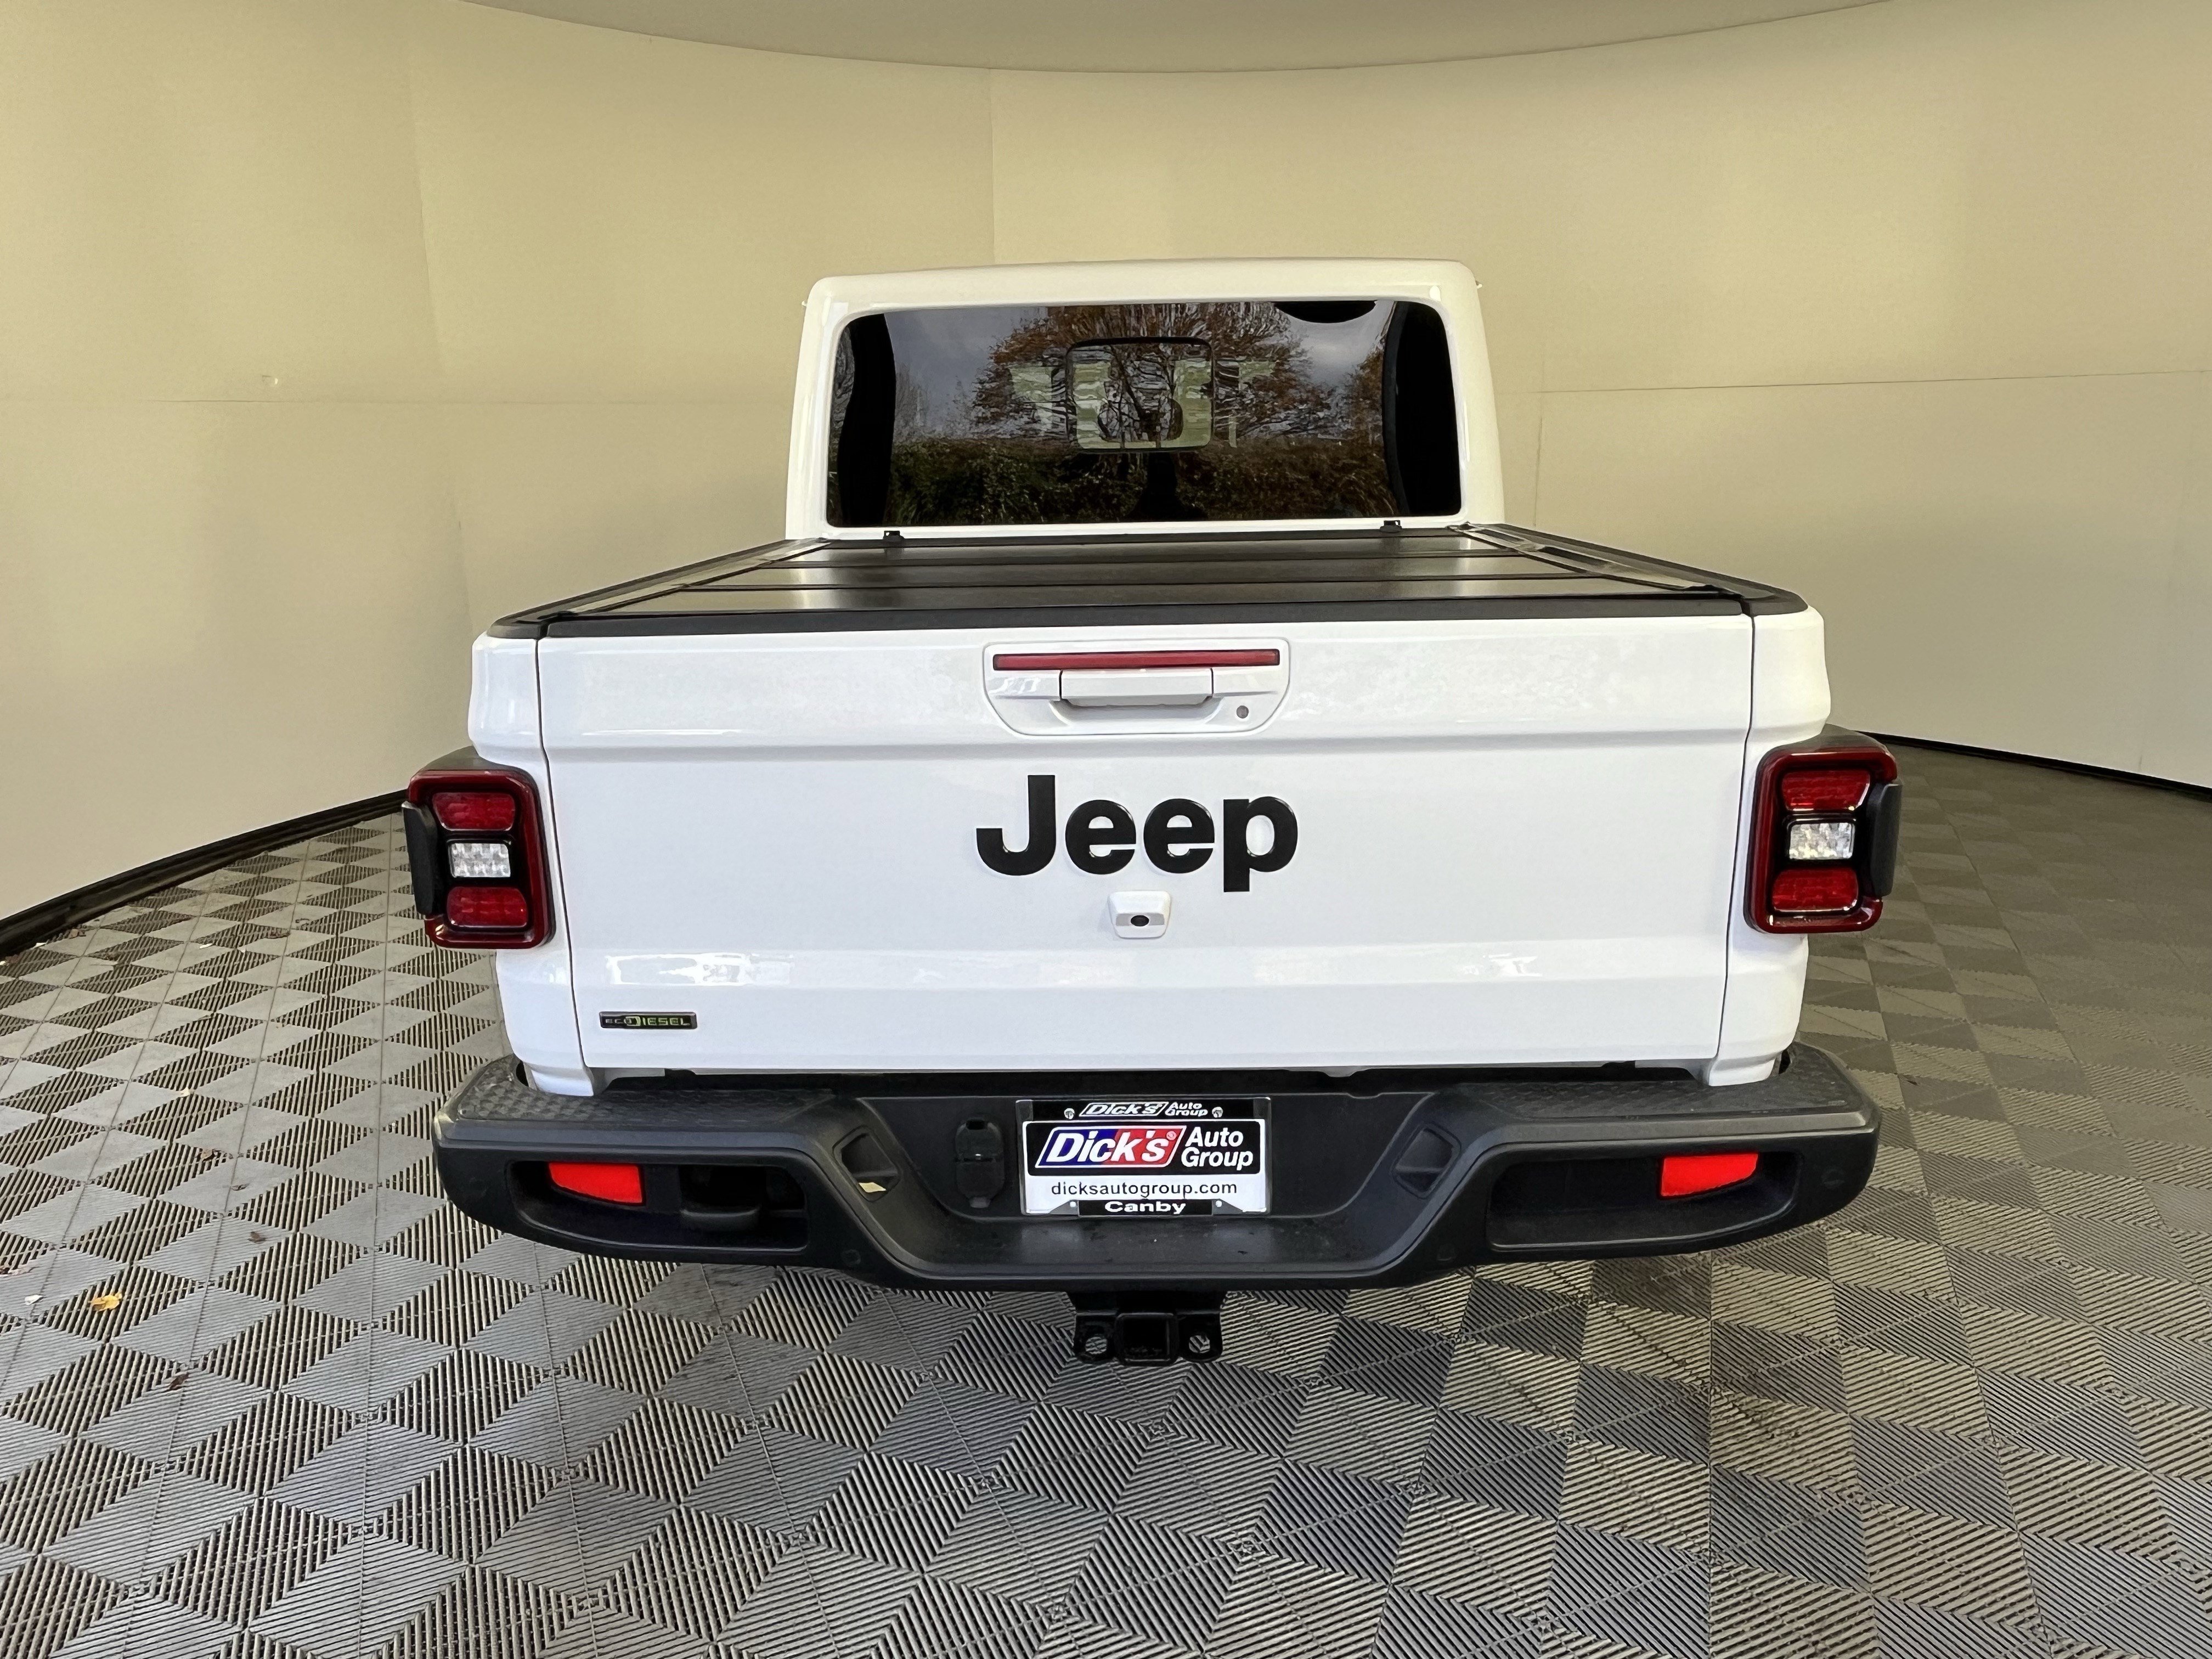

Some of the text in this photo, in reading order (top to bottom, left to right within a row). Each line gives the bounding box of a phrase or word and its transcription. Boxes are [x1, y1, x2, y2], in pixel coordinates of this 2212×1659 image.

[976, 775, 1299, 893] Jeep
[1085, 1103, 1162, 1115] Dick's
[1164, 1108, 1208, 1117] Group
[1169, 1102, 1203, 1110] Auto
[1185, 1126, 1244, 1147] Auto
[1046, 1130, 1169, 1162] Dick's
[1181, 1147, 1254, 1170] Group
[1051, 1182, 1237, 1198] dicksautogroup.com
[1104, 1200, 1186, 1215] Canby
